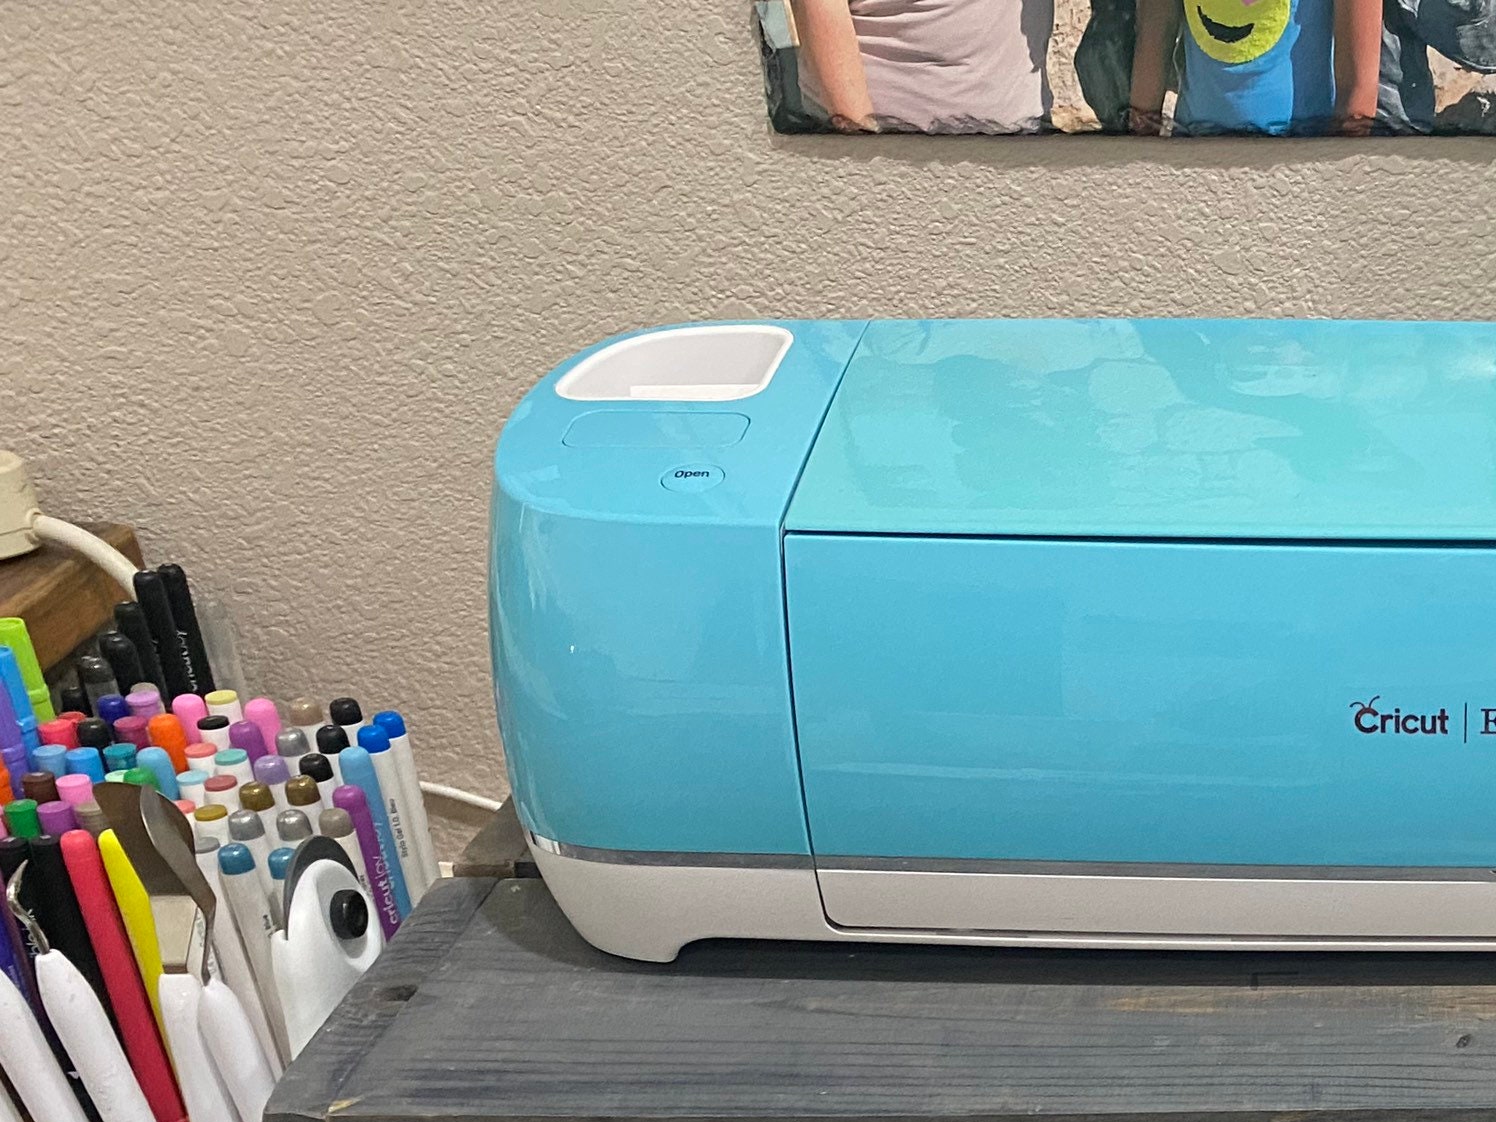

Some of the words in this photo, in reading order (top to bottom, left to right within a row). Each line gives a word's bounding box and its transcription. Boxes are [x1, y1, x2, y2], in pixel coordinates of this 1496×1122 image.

[674, 470, 710, 479] Open
[1350, 695, 1450, 735] Cricut
[378, 879, 399, 925] cricut
